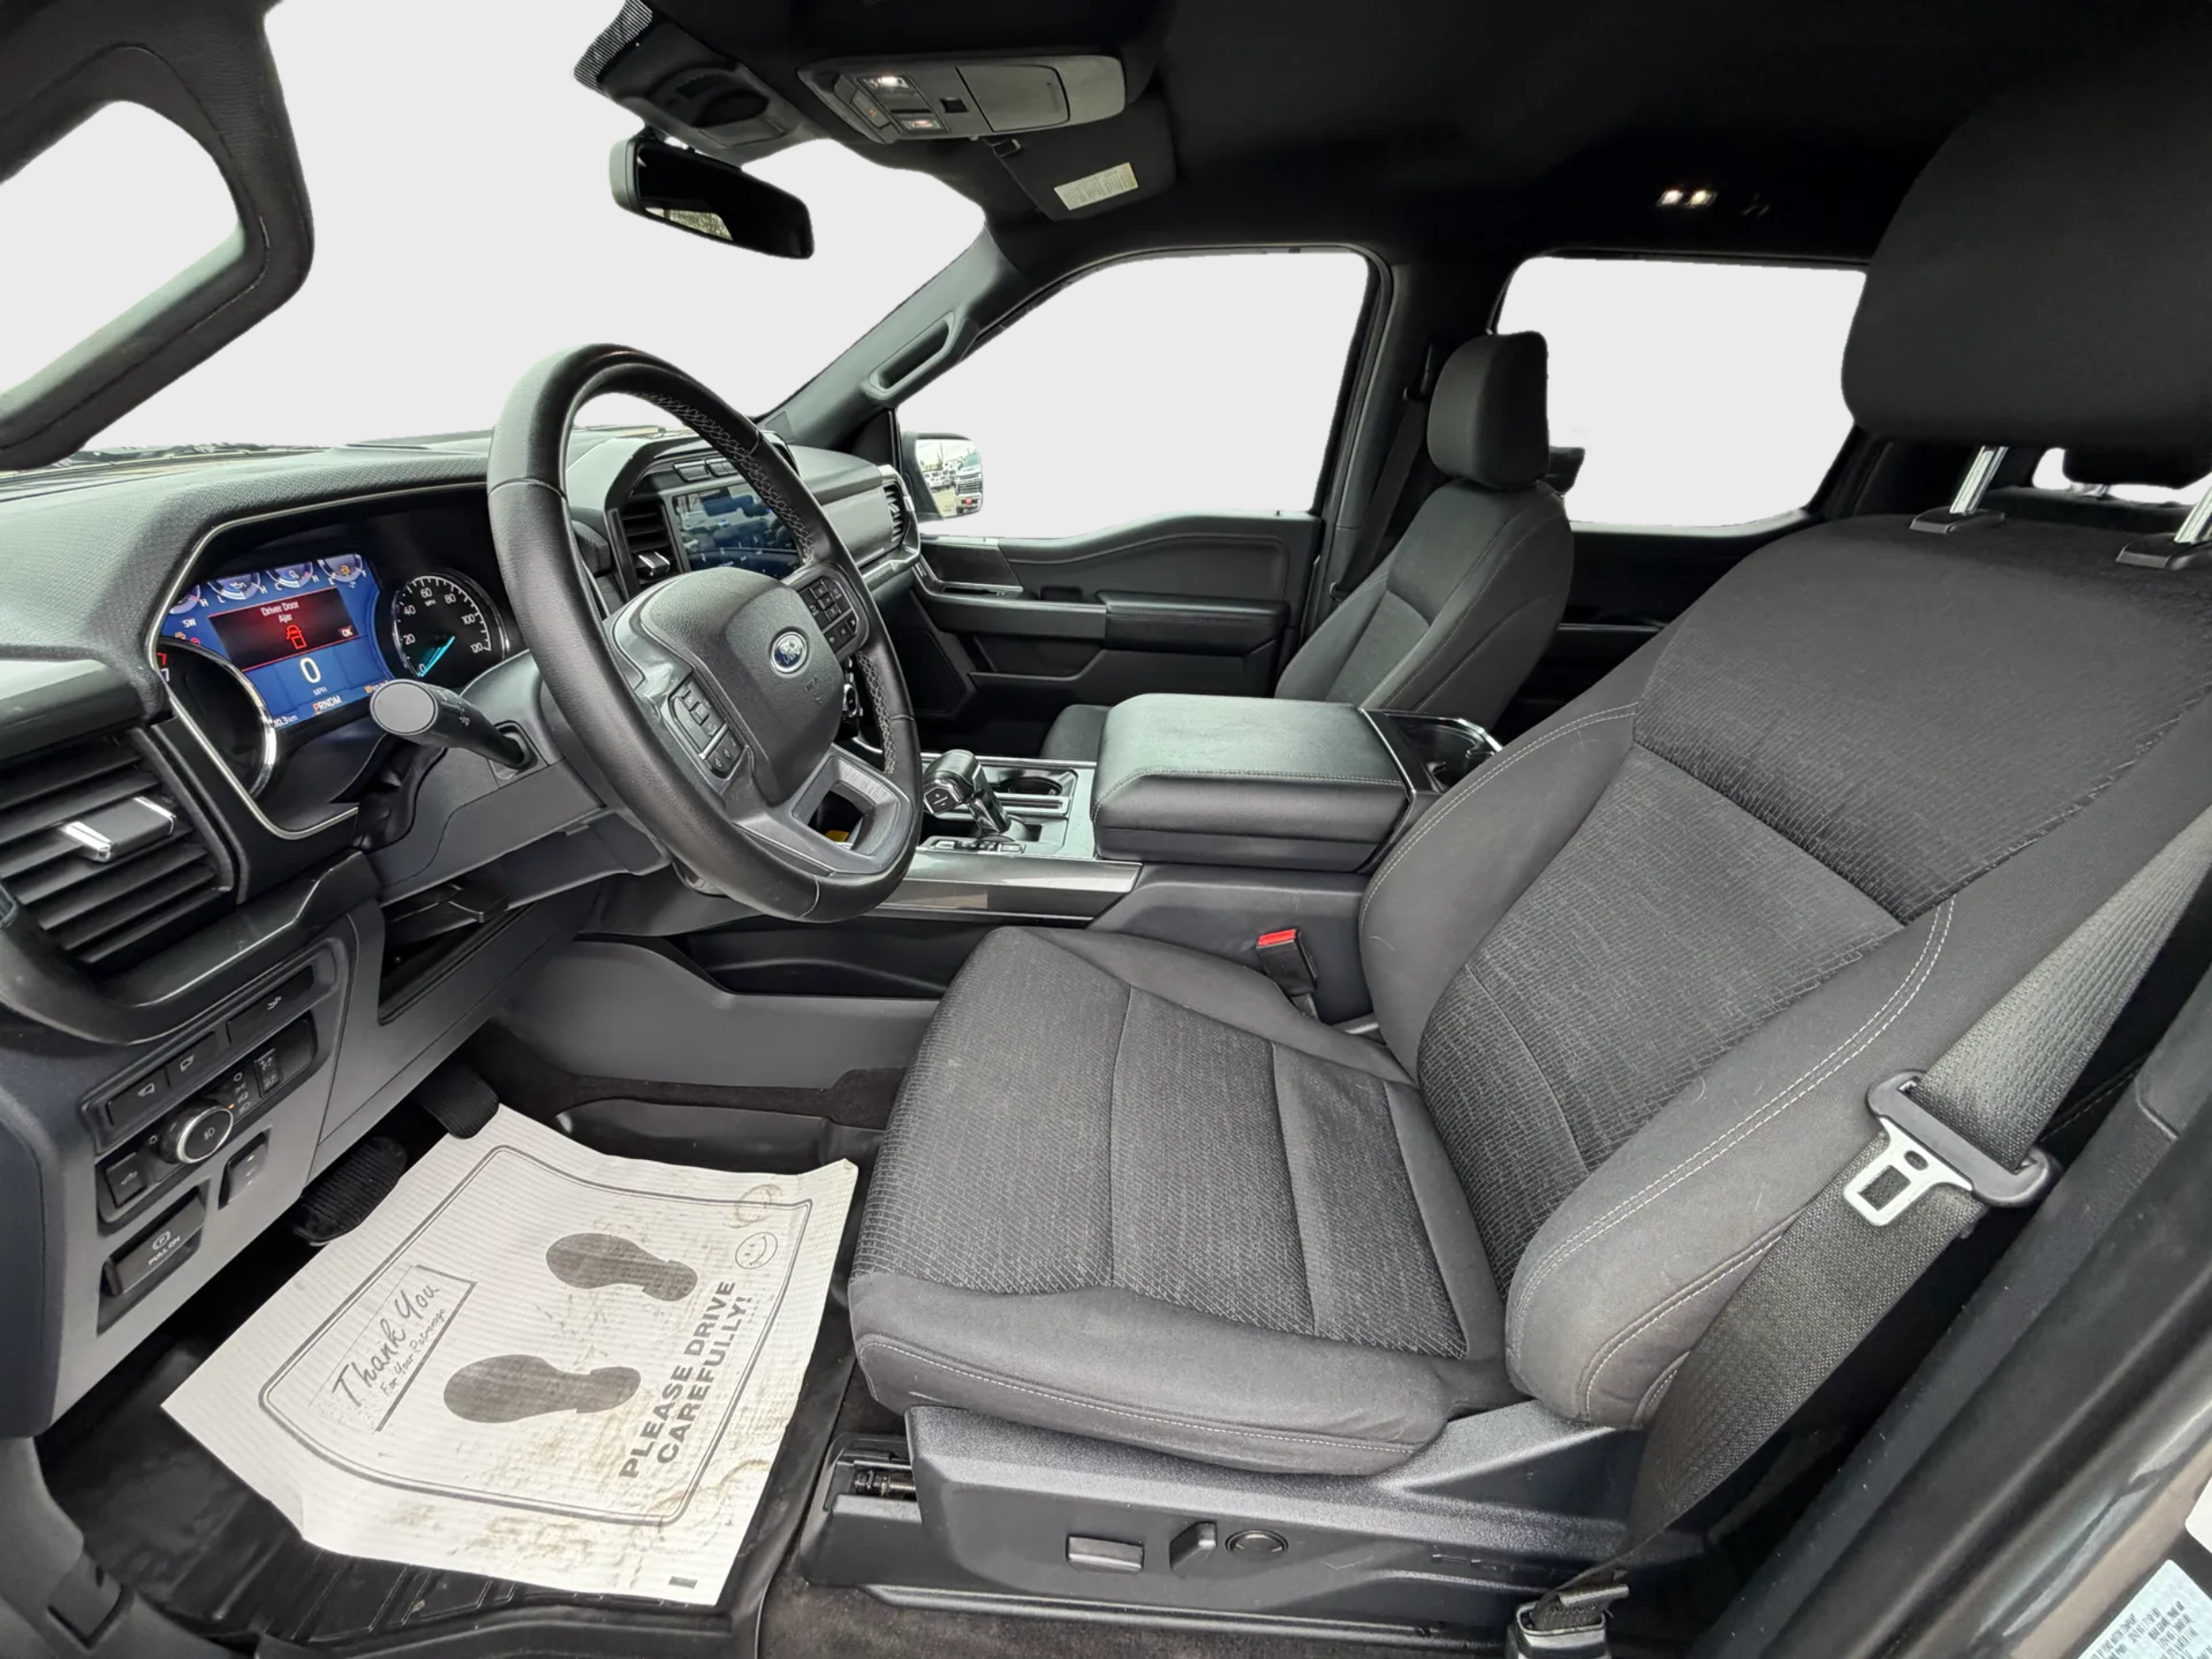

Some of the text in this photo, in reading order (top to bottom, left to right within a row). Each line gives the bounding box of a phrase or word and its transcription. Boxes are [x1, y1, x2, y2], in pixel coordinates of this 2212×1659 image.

[420, 588, 433, 598] 60
[444, 593, 457, 604] 80
[199, 598, 209, 607] H
[260, 602, 299, 617] Driver Door
[404, 604, 417, 615] 40
[182, 618, 196, 628] SW
[278, 614, 293, 624] Ajar
[461, 614, 476, 625] 100
[341, 627, 353, 637] OK
[403, 634, 416, 645] 20
[470, 642, 484, 653] 120
[300, 657, 321, 684] 0
[419, 664, 426, 672] 0
[312, 687, 327, 696] MPH
[313, 695, 342, 712] PRNDM
[149, 1235, 180, 1265] PULL ON
[331, 1285, 441, 1407] Thank You
[618, 1281, 736, 1478] PLEASE DRIVE
[657, 1295, 752, 1464] CAREFULLY!
[380, 1378, 398, 1396] For
